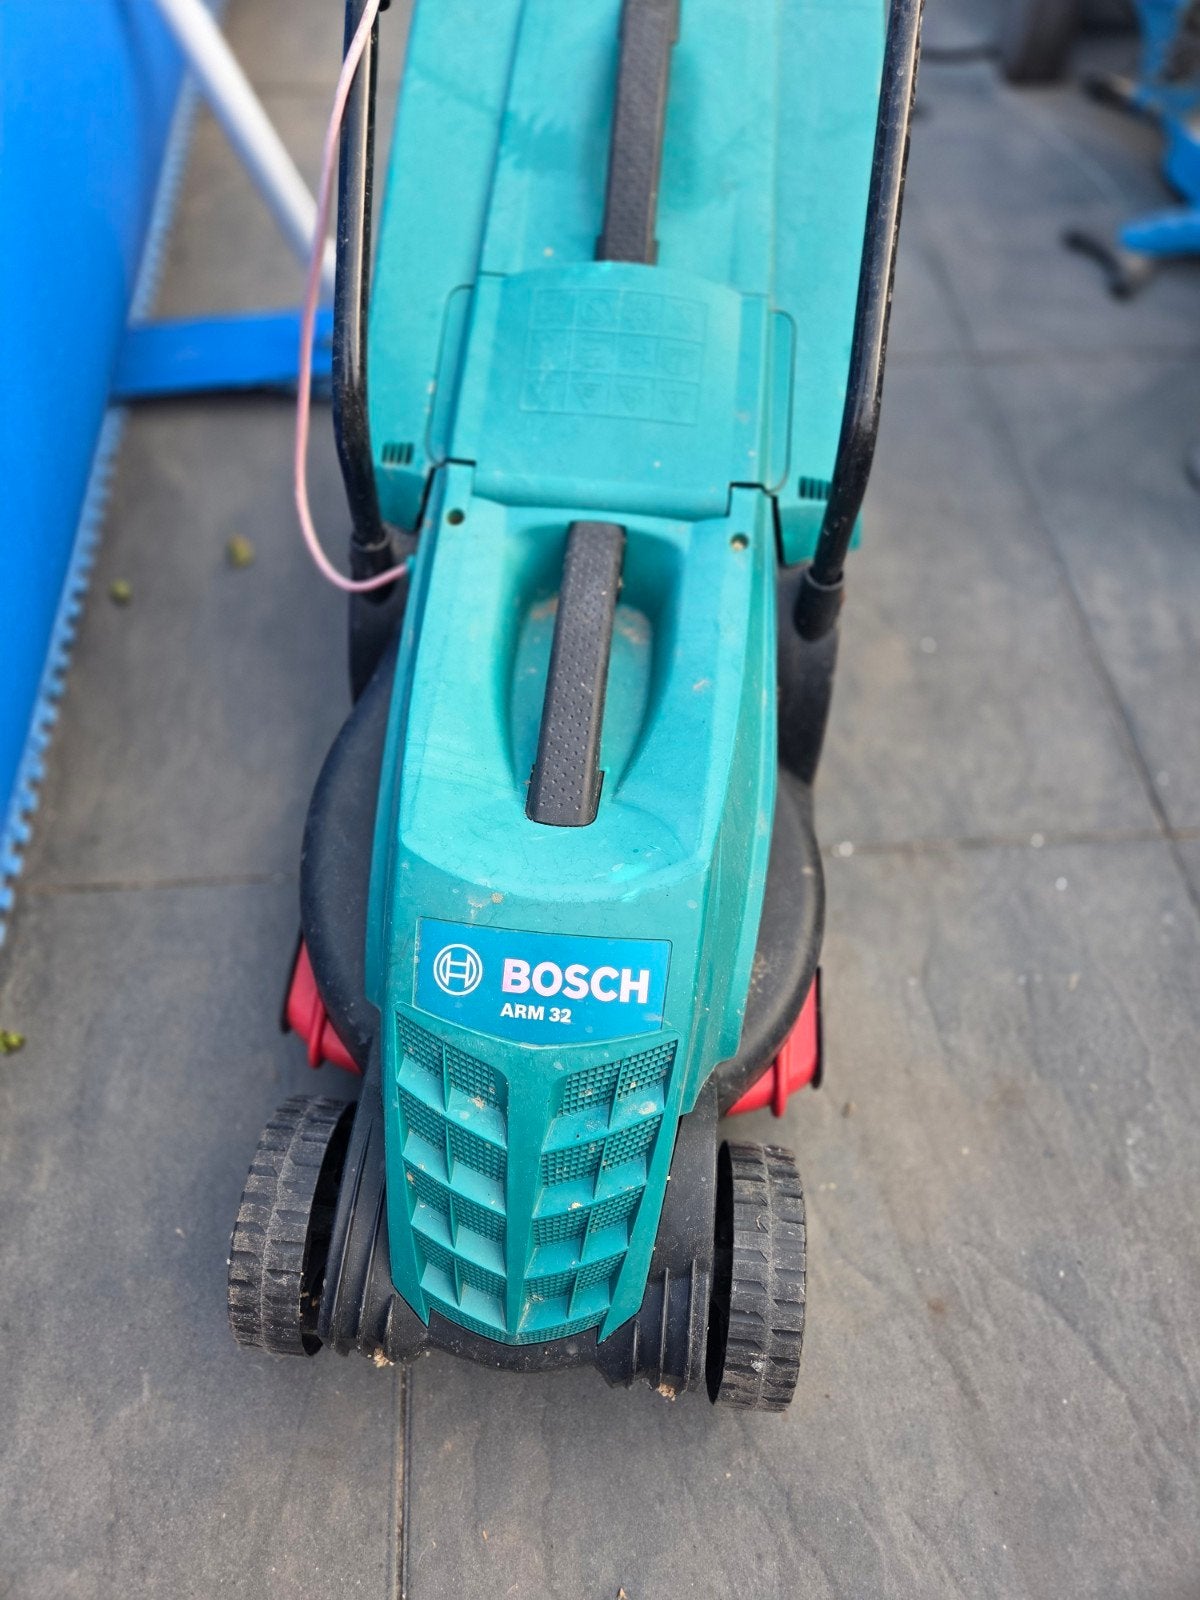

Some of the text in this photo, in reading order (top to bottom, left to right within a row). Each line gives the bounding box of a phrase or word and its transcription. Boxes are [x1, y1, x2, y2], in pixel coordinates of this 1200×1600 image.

[502, 958, 649, 1004] BOSCH
[500, 1003, 572, 1023] ARM 32
